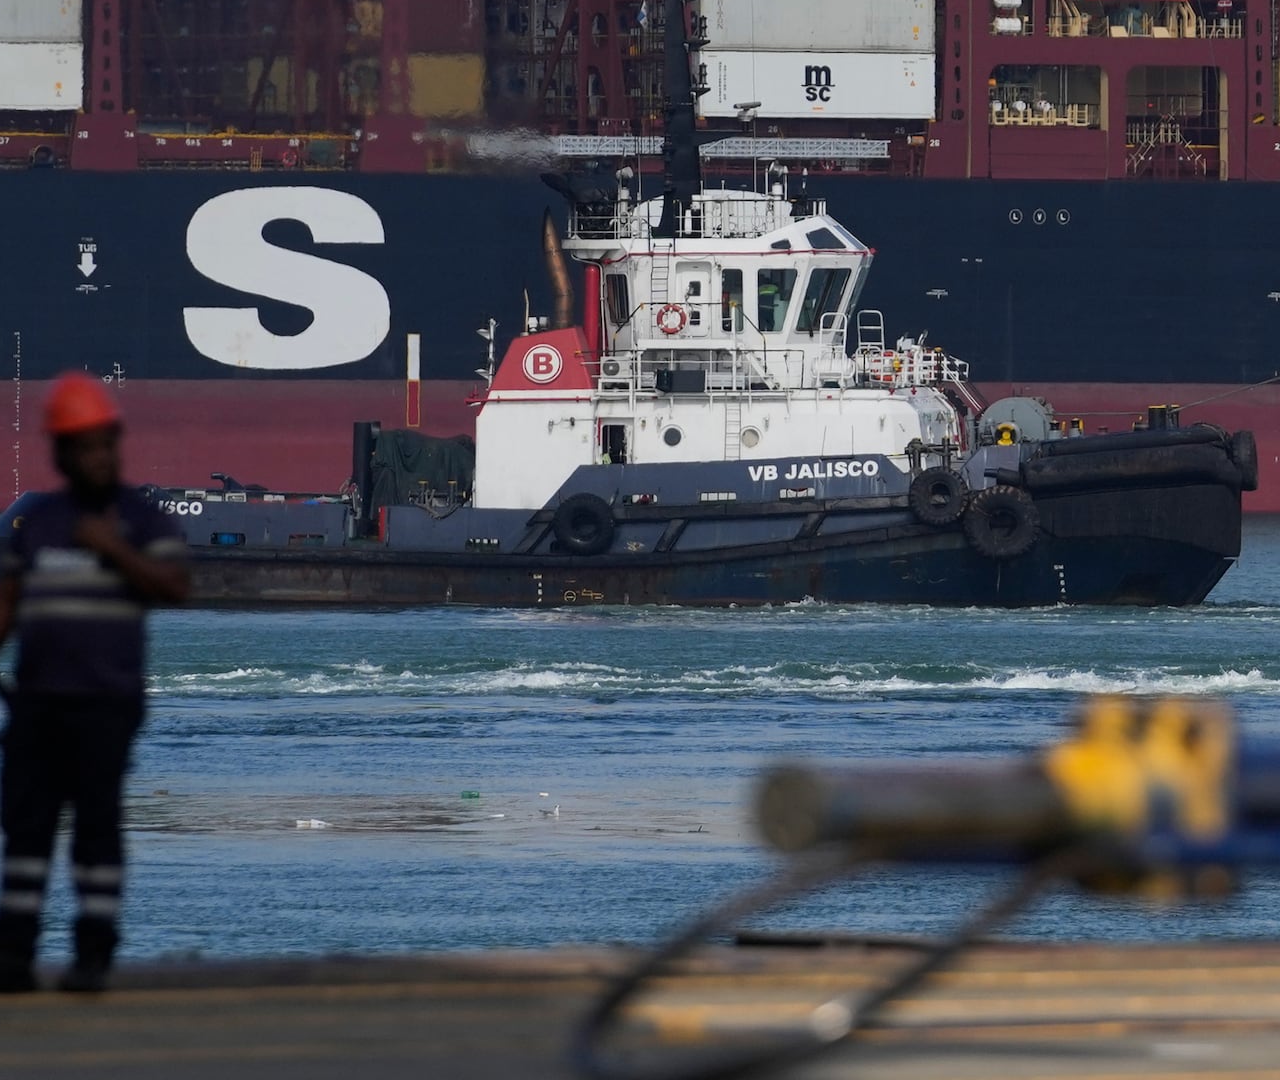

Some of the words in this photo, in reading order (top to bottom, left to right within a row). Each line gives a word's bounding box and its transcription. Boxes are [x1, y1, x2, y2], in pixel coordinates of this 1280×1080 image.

[78, 243, 97, 253] TUG
[183, 186, 390, 369] S
[533, 353, 553, 375] B
[748, 465, 778, 482] VB
[784, 460, 879, 480] JALISCO
